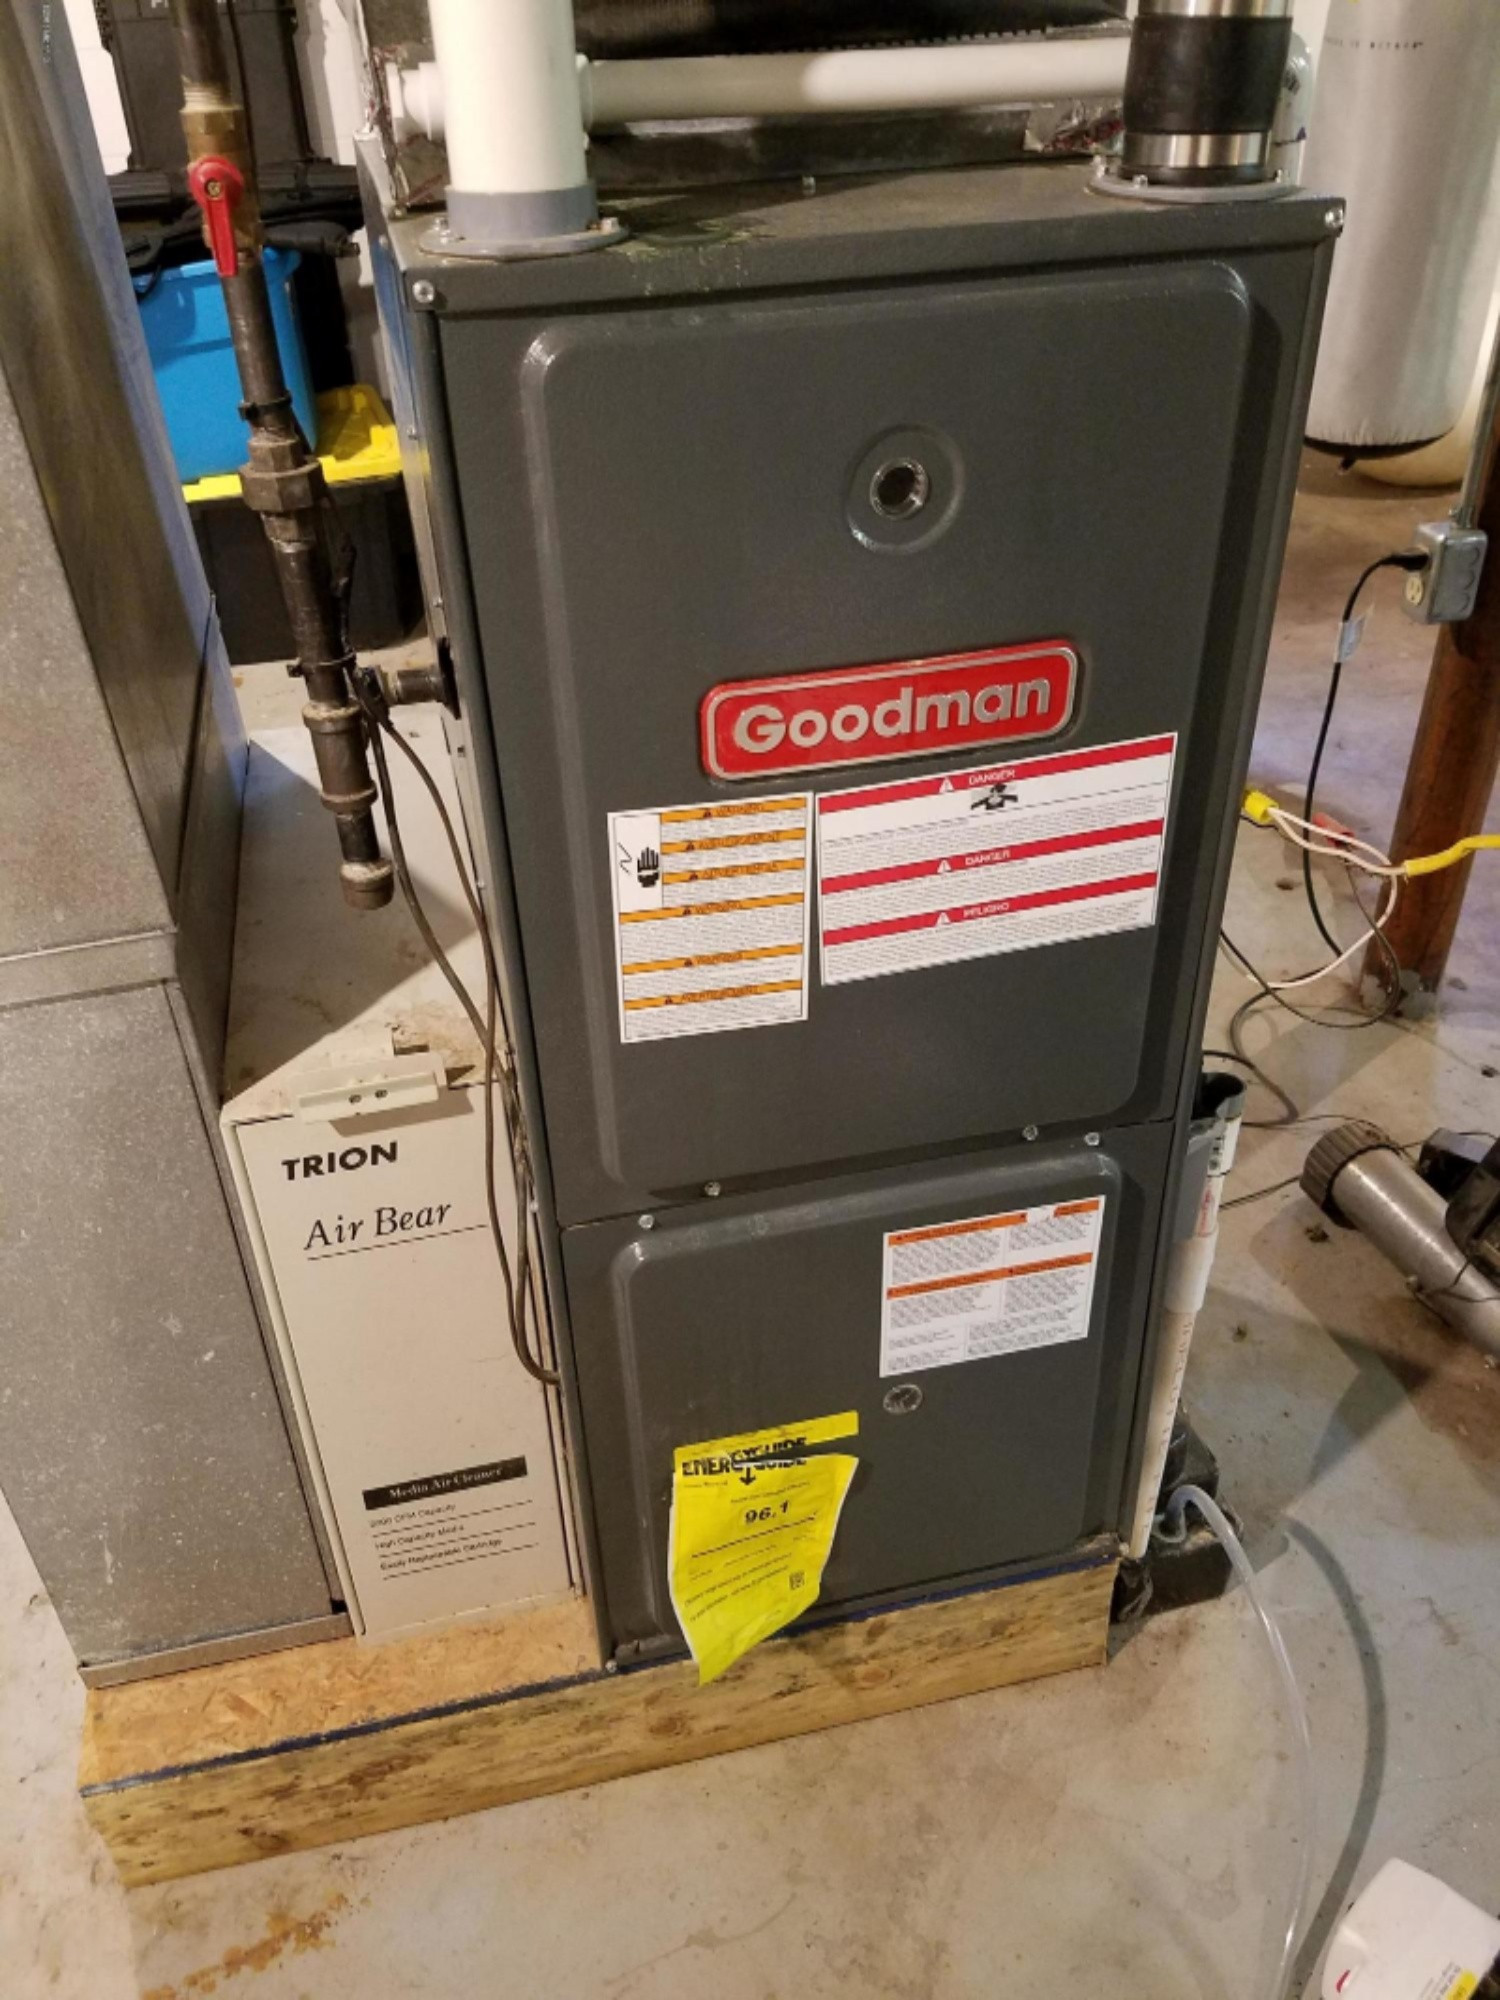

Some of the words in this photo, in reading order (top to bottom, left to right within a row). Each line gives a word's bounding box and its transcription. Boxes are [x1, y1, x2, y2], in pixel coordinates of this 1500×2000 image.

[733, 677, 1051, 754] Goodman
[969, 769, 1015, 785] DANGER
[965, 850, 1011, 866] DANGER
[963, 903, 1009, 919] PELIGRO
[281, 1141, 398, 1180] TRION
[303, 1214, 364, 1250] Air
[374, 1203, 451, 1237] Bear
[390, 1484, 428, 1498] Media
[431, 1479, 452, 1492] Air
[453, 1468, 503, 1486] Cleaner
[745, 1500, 789, 1524] 96.1
